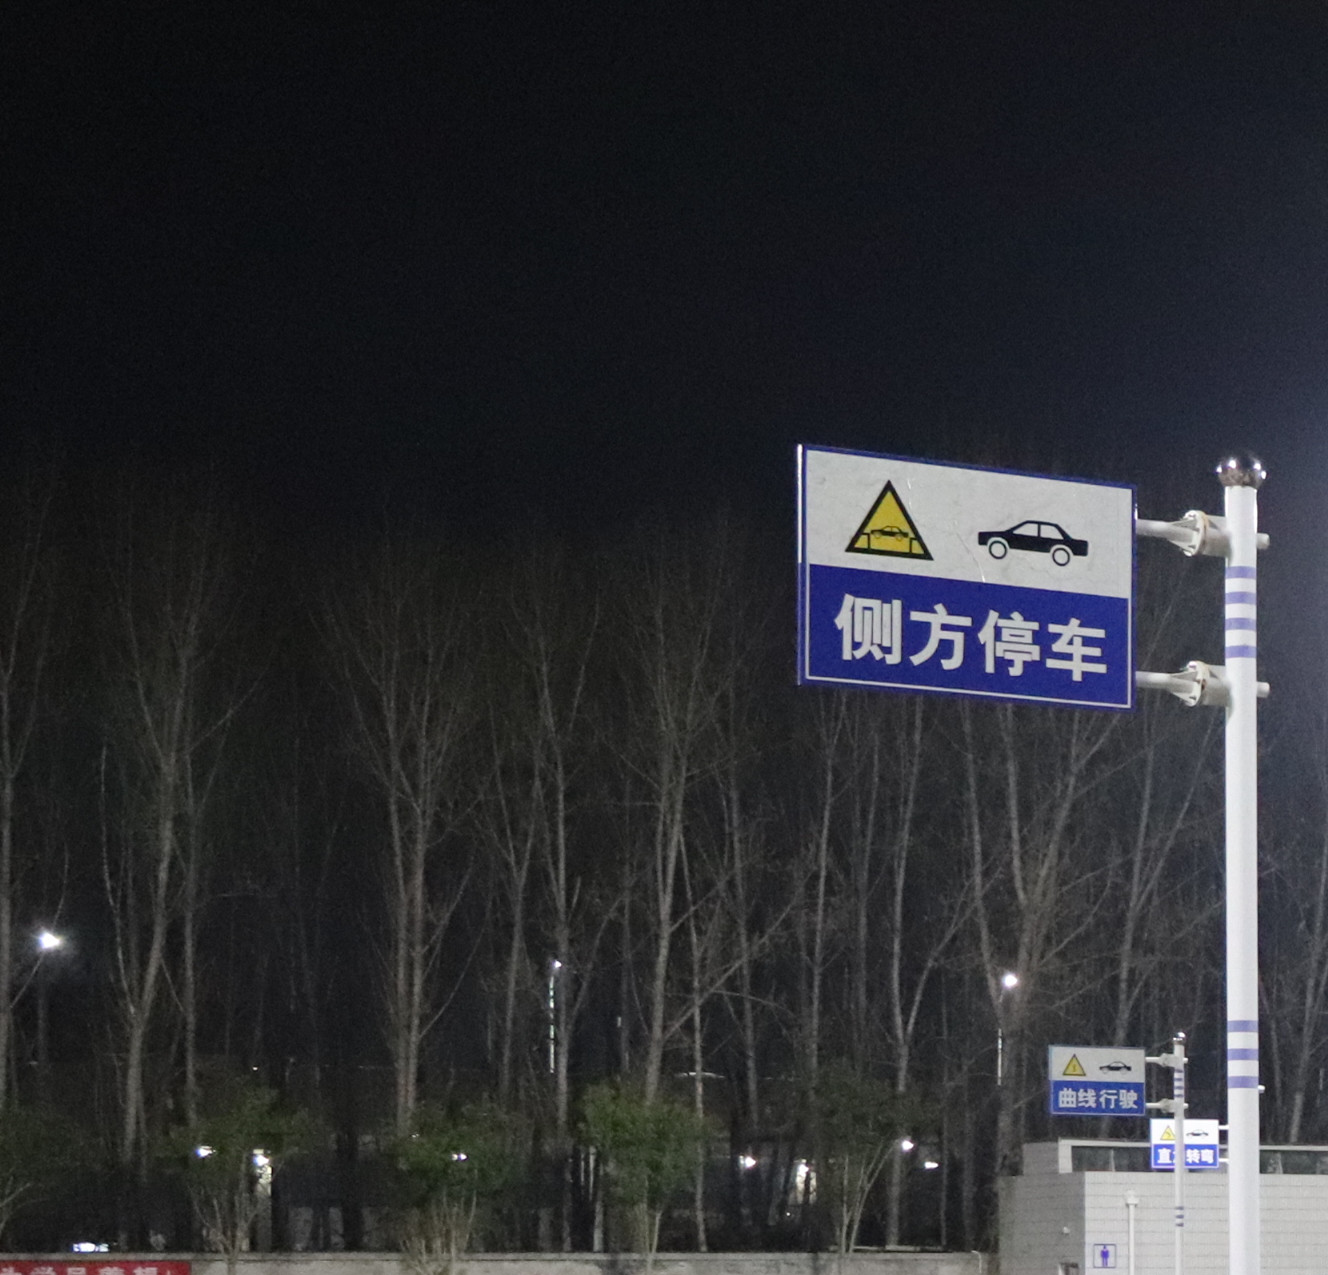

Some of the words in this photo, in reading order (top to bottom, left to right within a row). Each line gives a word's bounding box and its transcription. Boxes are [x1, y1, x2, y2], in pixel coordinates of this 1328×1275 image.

[835, 594, 1107, 682] 侧方停车
[1058, 1087, 1138, 1109] 曲线行驶
[1157, 1148, 1214, 1164] 直转弯
